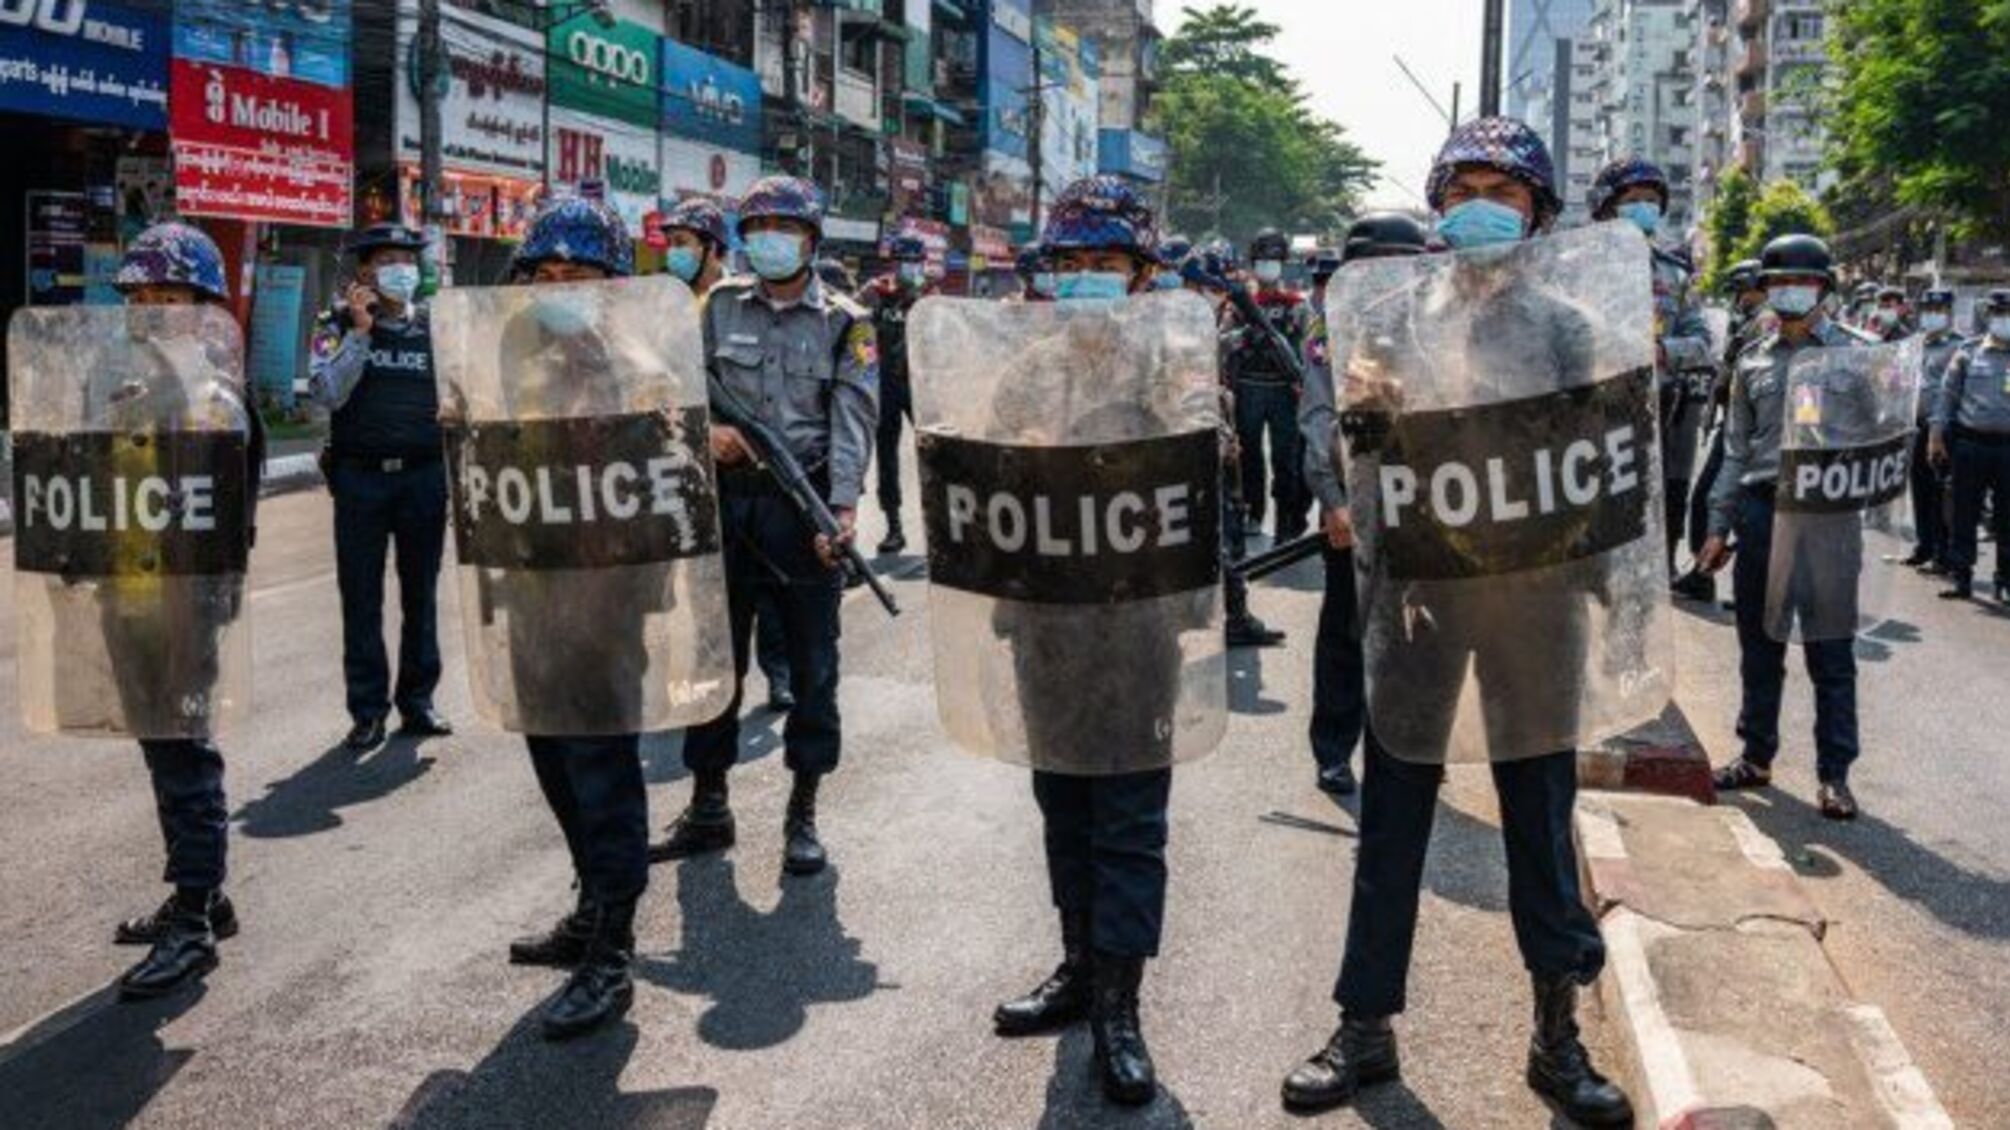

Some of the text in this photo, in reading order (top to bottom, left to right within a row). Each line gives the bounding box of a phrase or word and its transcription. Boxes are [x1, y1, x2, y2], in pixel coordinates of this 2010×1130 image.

[83, 19, 144, 51] MOBILE
[230, 92, 312, 137] Mobile
[558, 127, 604, 184] HH
[606, 153, 660, 194] Mobile
[24, 474, 216, 531] POLICE
[466, 454, 686, 524] POLICE
[1380, 425, 1638, 528] POLICE
[1795, 451, 1907, 499] POLICE
[946, 483, 1192, 556] POLICE
